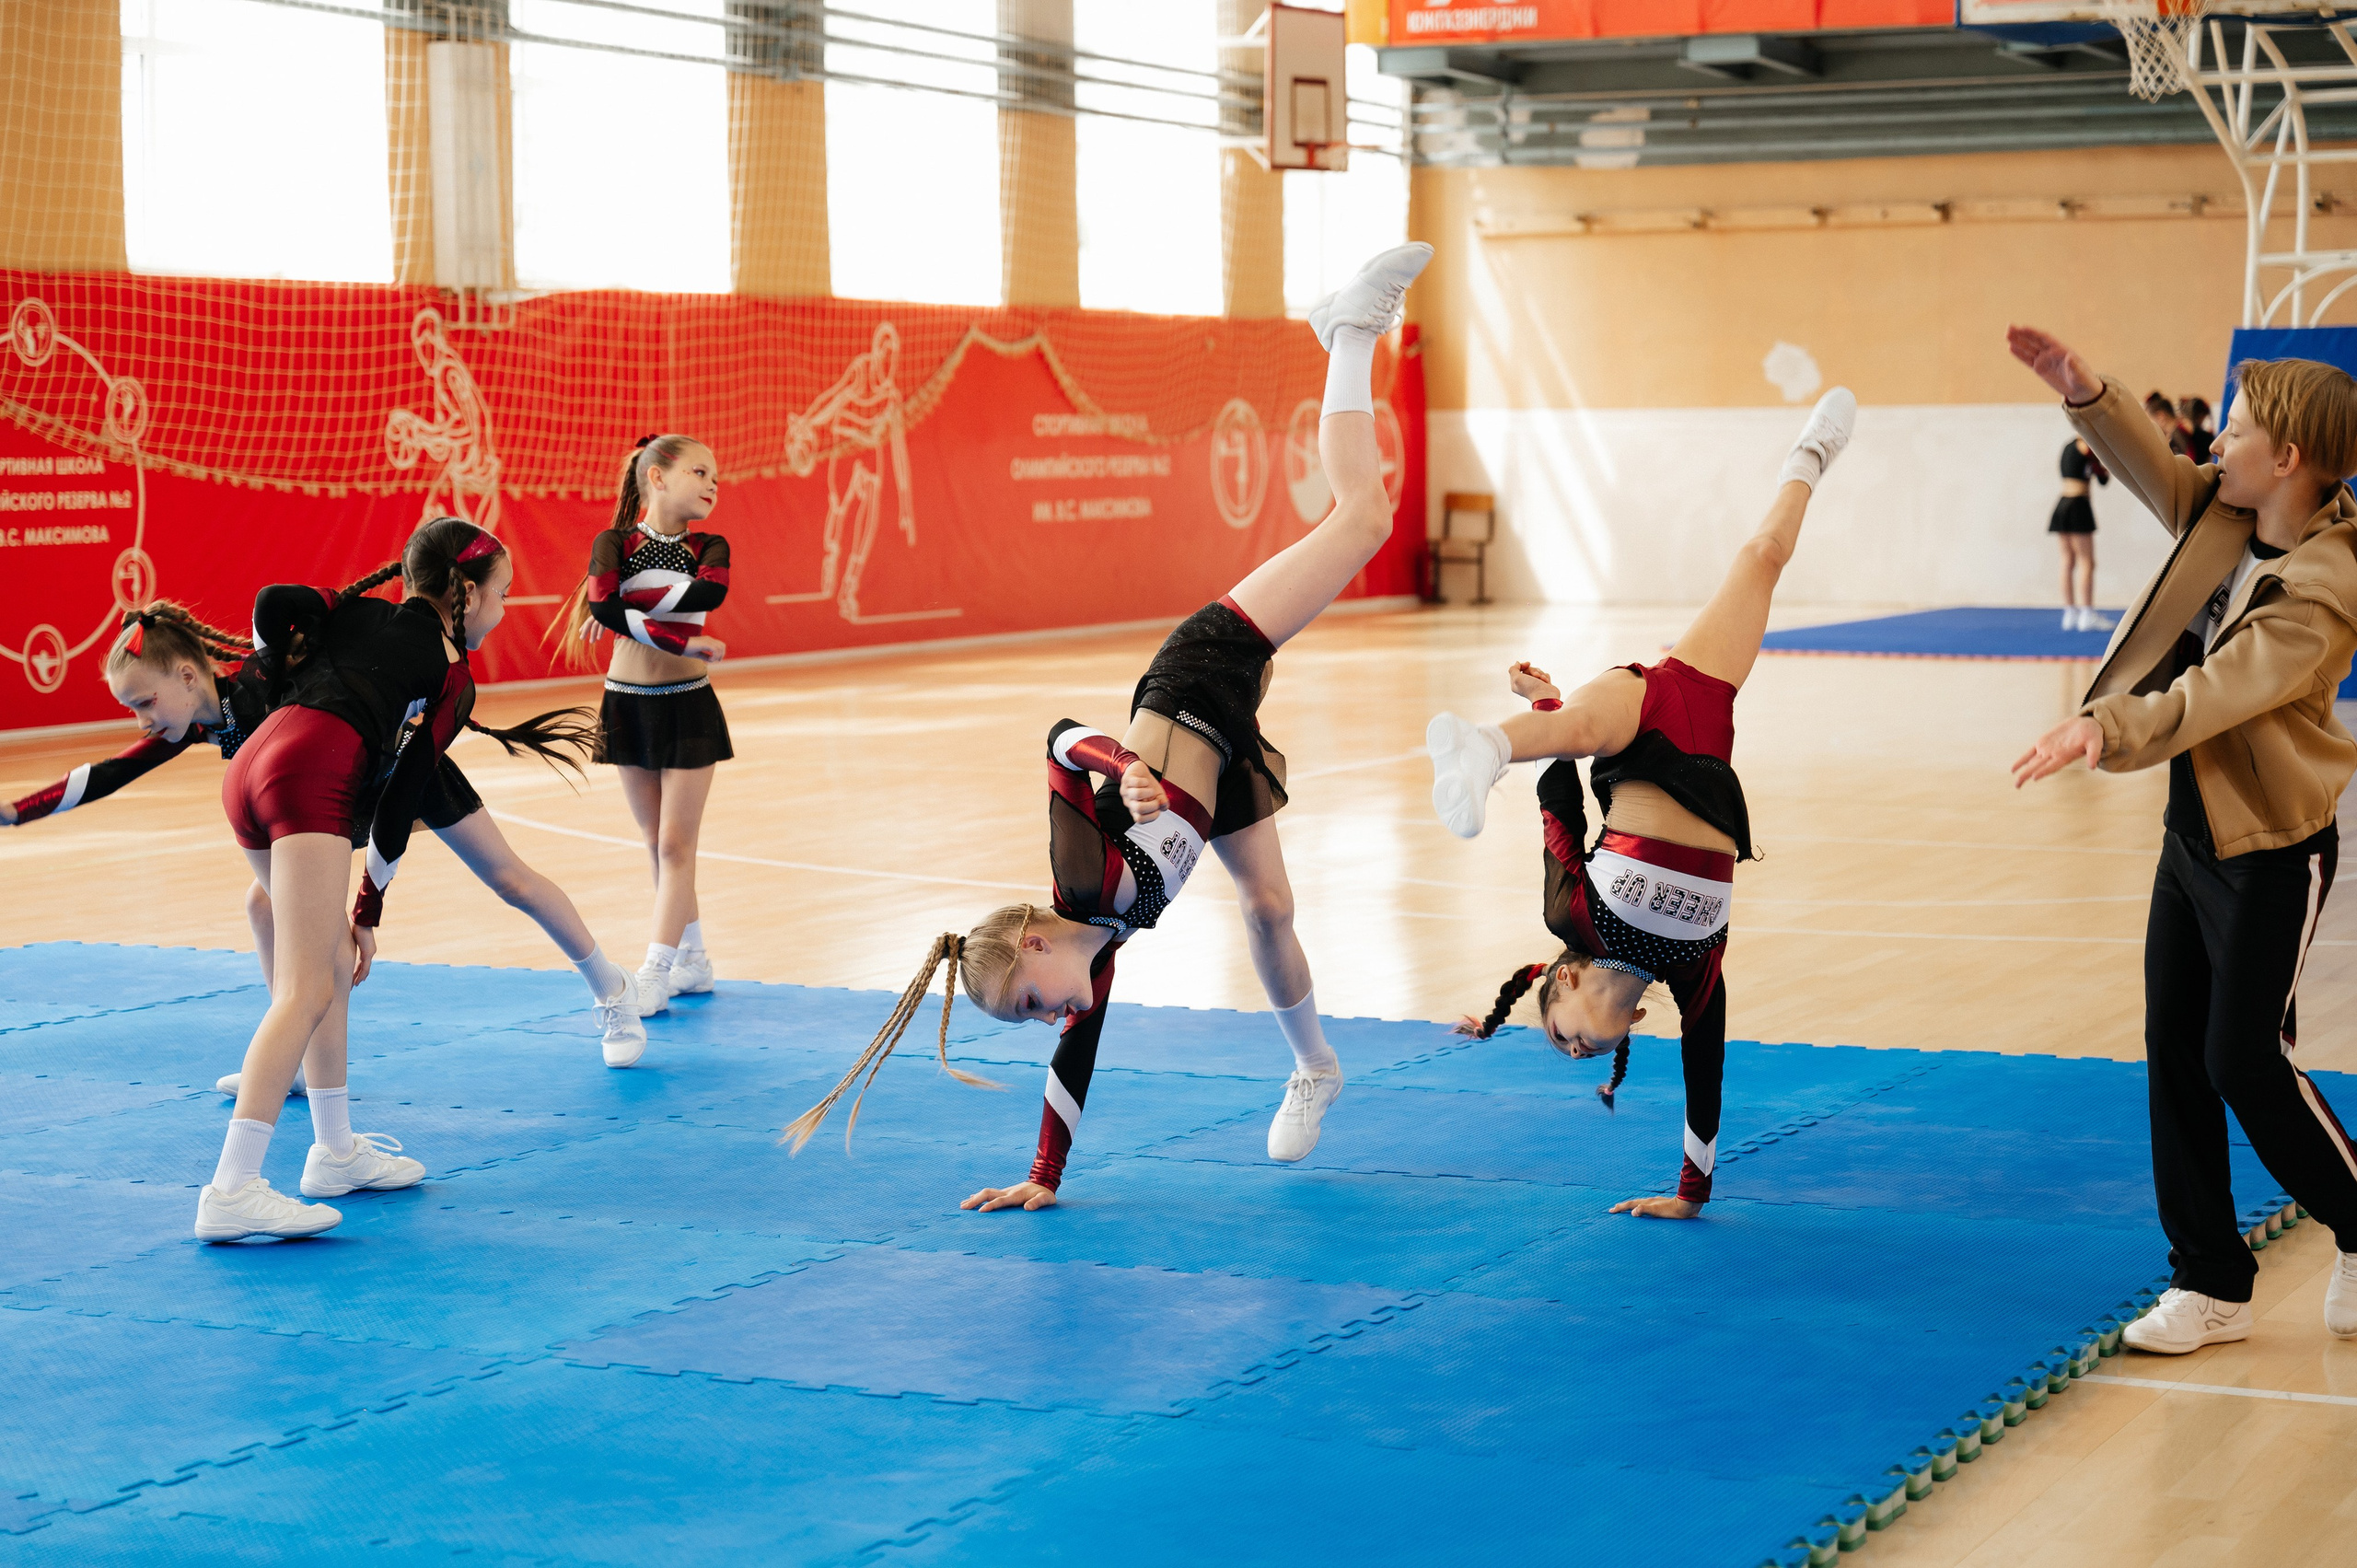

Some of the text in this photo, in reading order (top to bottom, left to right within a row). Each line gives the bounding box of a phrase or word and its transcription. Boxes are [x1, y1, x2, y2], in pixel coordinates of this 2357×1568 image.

[55, 456, 106, 475] ШКОЛА
[57, 490, 109, 510] РЕЗЕРВА
[24, 525, 110, 546] МАКСИМОВА
[1159, 830, 1189, 869] UP
[1609, 868, 1724, 927] CHEER UP
